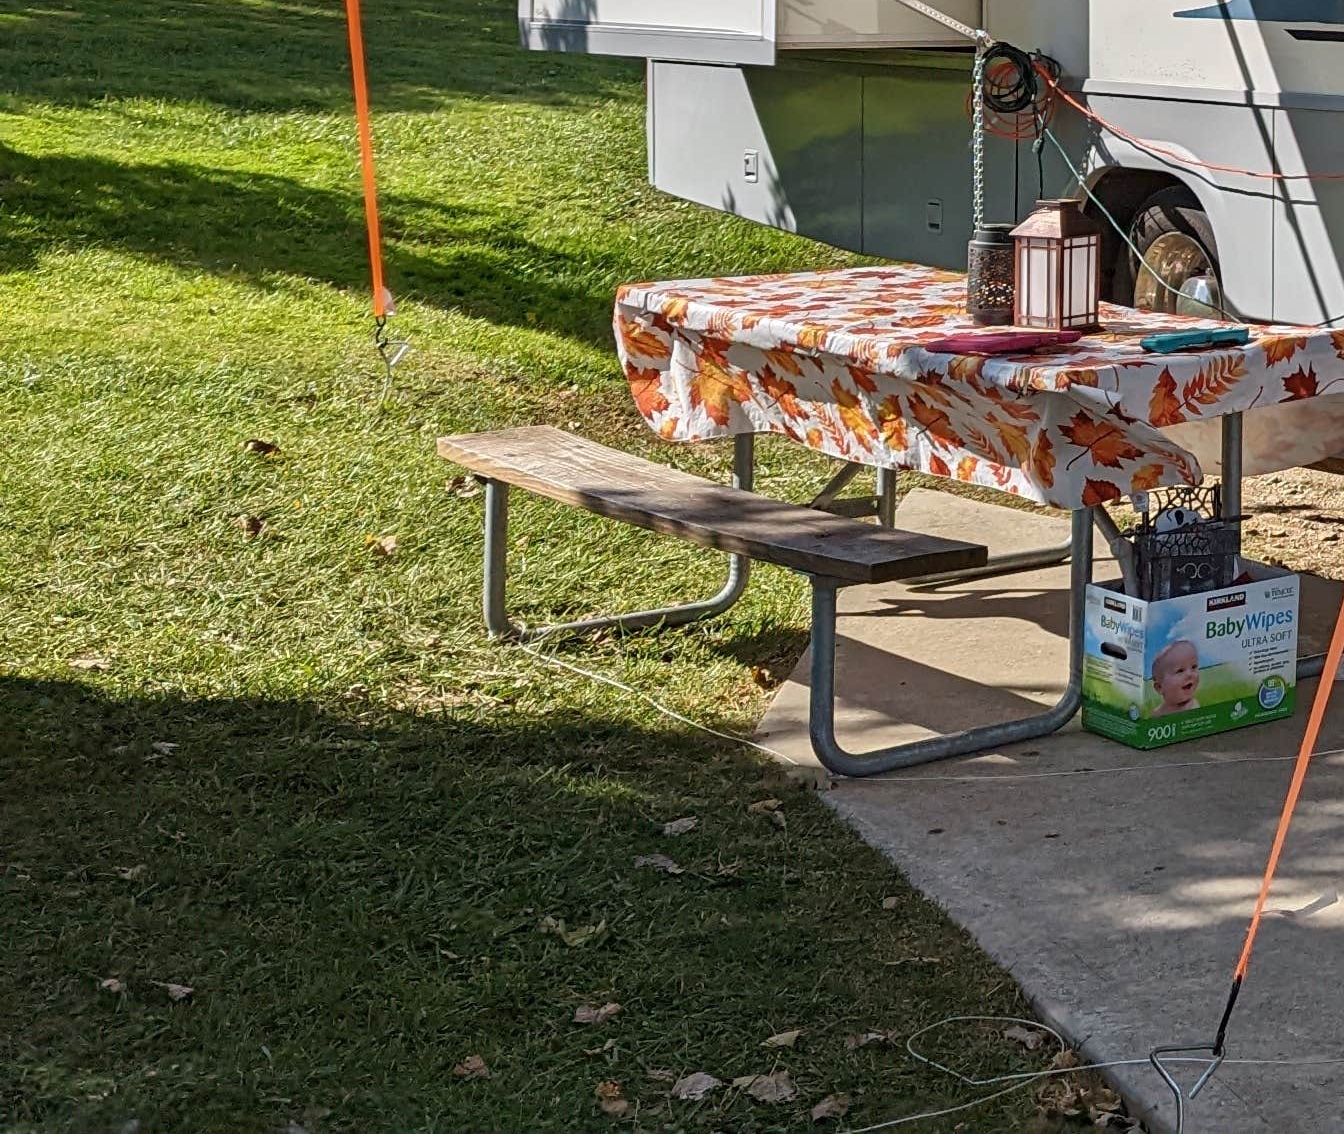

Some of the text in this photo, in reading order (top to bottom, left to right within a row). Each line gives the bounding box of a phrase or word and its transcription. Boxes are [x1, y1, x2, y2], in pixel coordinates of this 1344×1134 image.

[1208, 593, 1245, 607] KIRKLAND
[1241, 629, 1293, 649] ULTRA SOFT
[1147, 724, 1171, 742] 900
